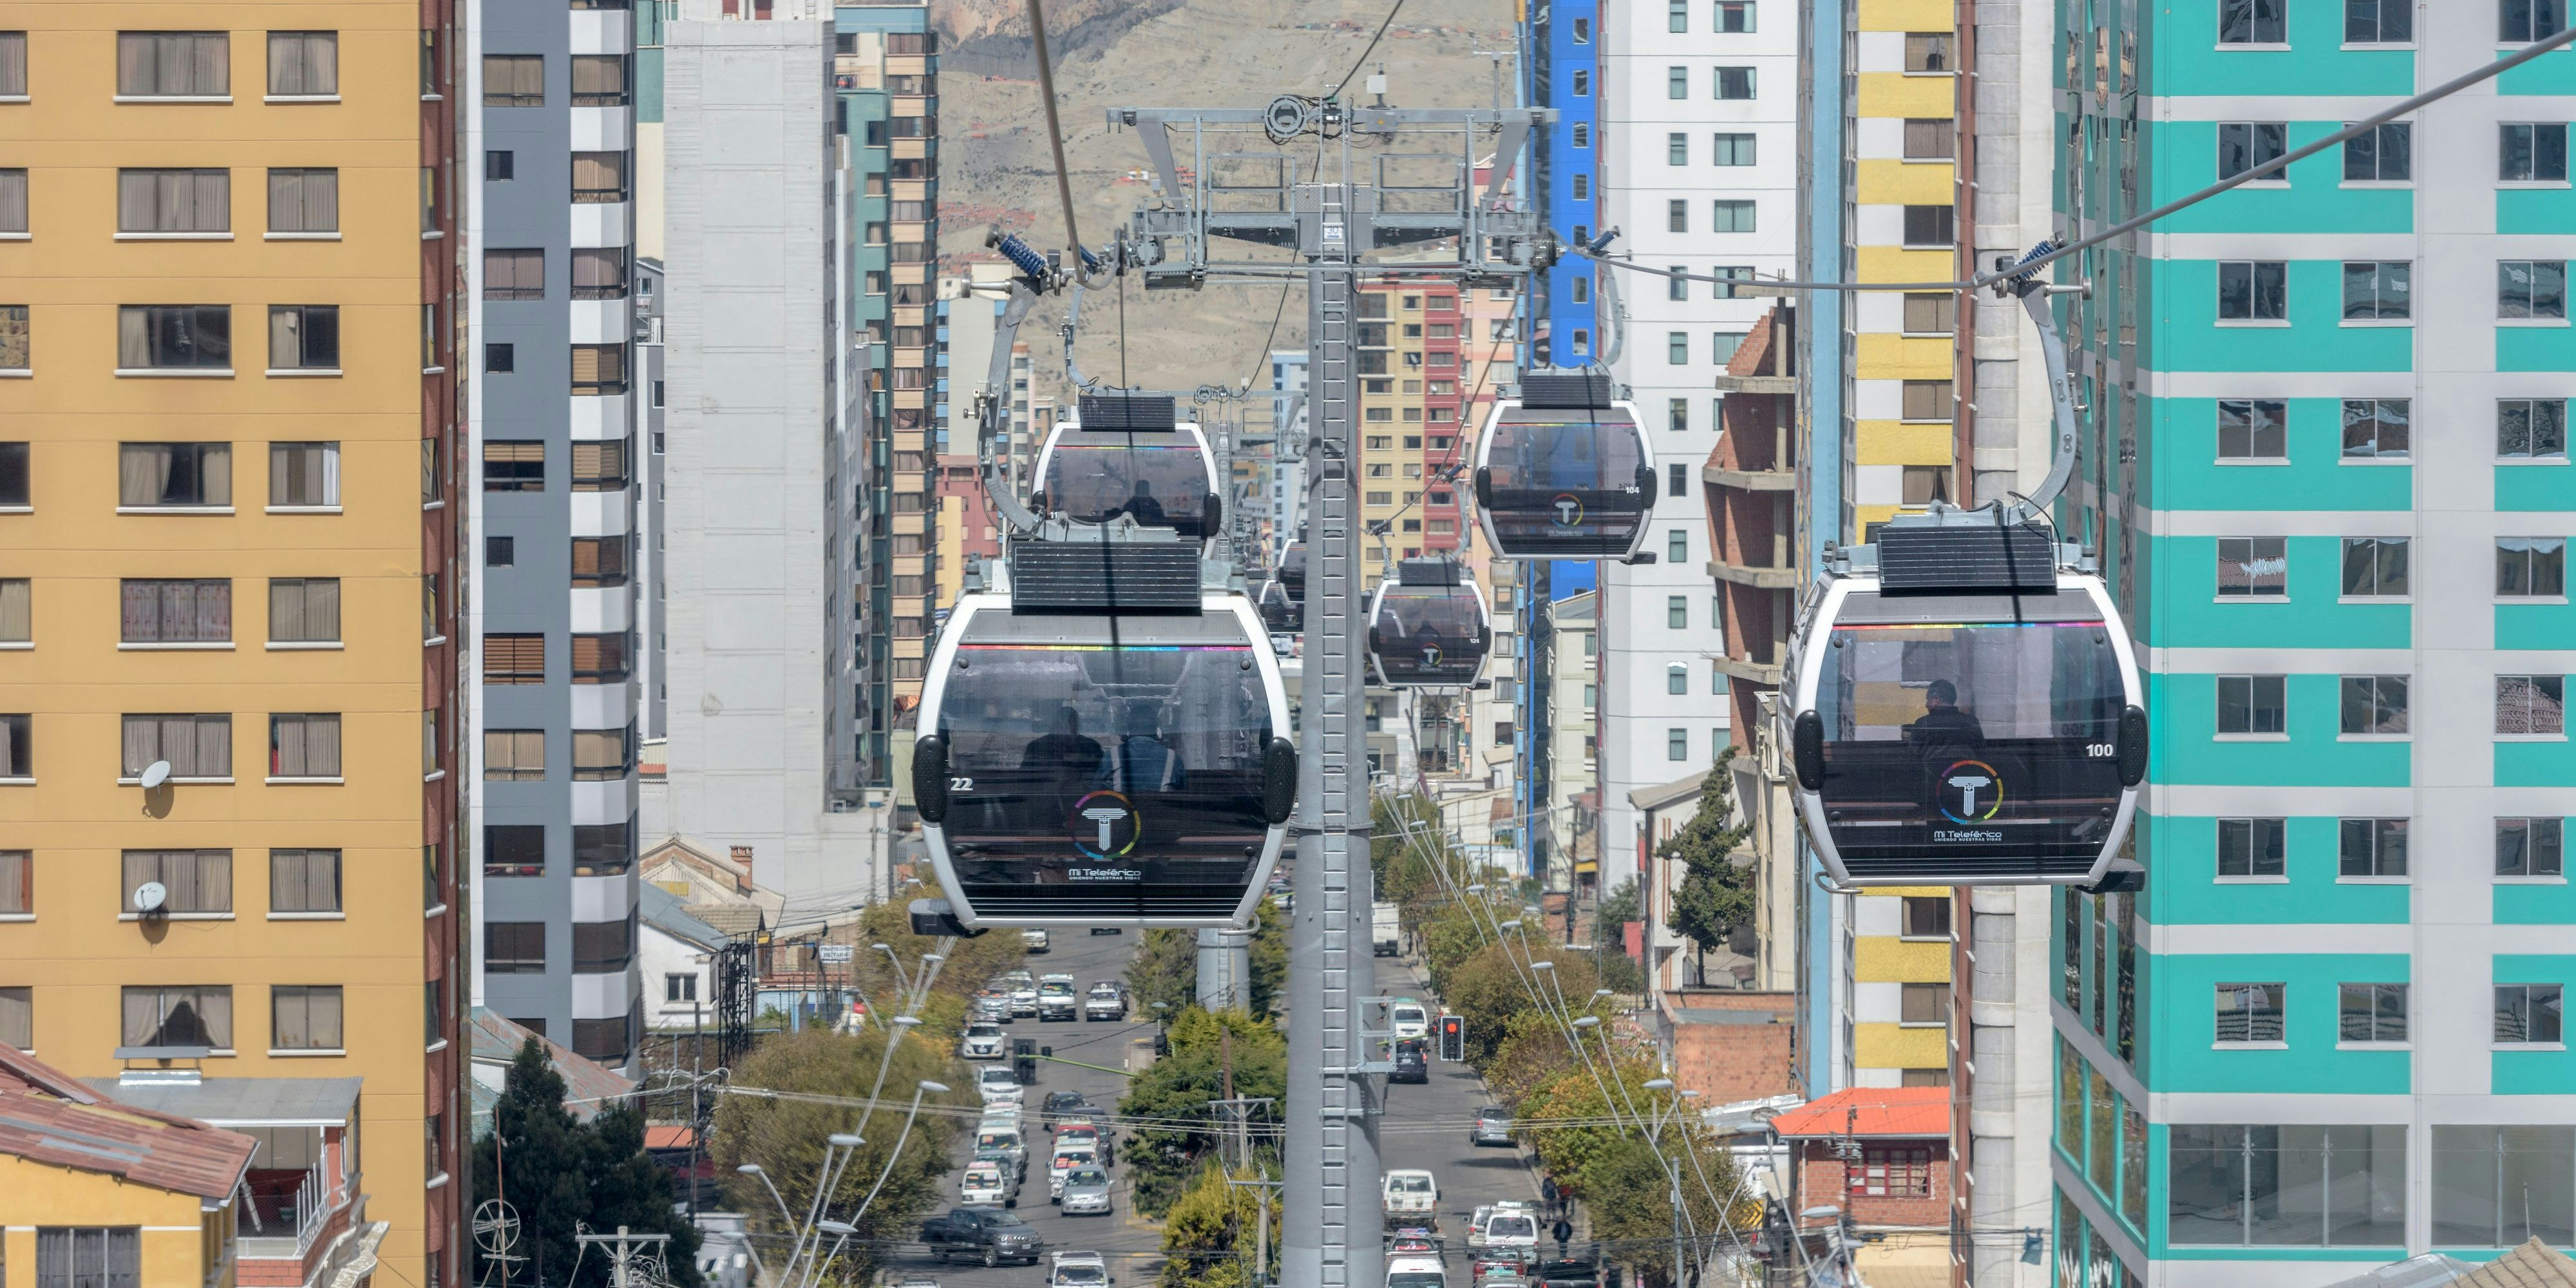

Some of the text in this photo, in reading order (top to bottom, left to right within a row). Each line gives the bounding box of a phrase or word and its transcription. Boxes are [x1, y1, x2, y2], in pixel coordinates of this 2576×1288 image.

[1327, 226, 1339, 234] 30
[2086, 744, 2114, 757] 100
[951, 777, 974, 791] 22
